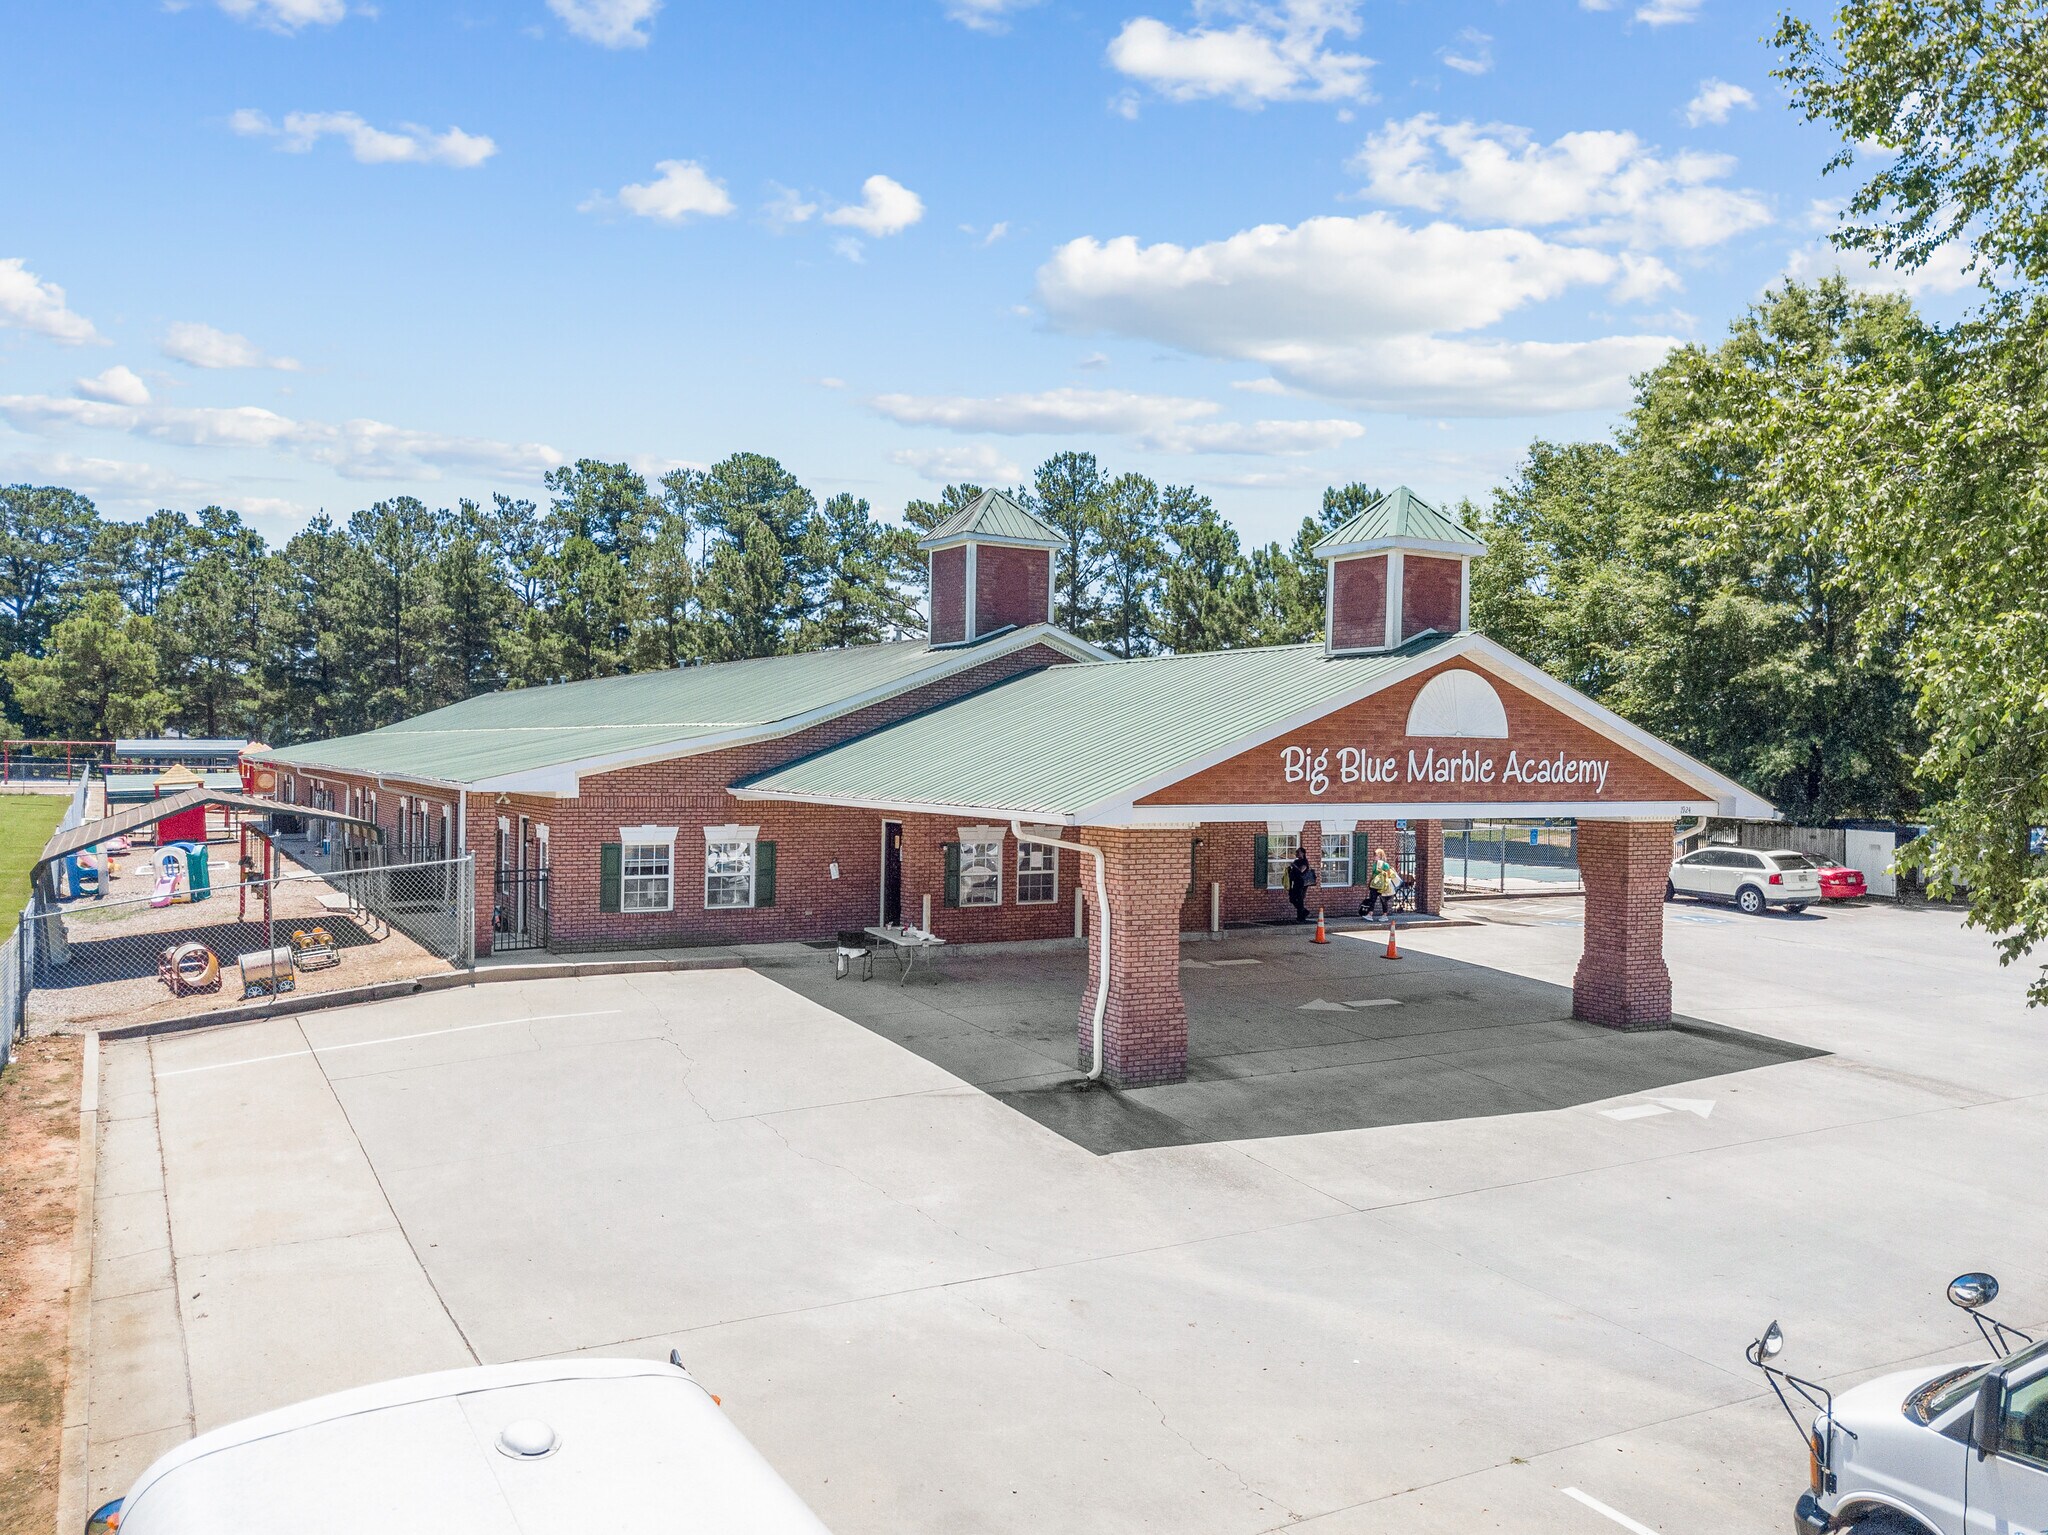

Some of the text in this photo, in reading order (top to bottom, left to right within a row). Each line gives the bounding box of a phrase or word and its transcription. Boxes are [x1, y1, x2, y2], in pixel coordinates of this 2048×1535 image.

[1280, 746, 1609, 795] Big Blue Marble Academy
